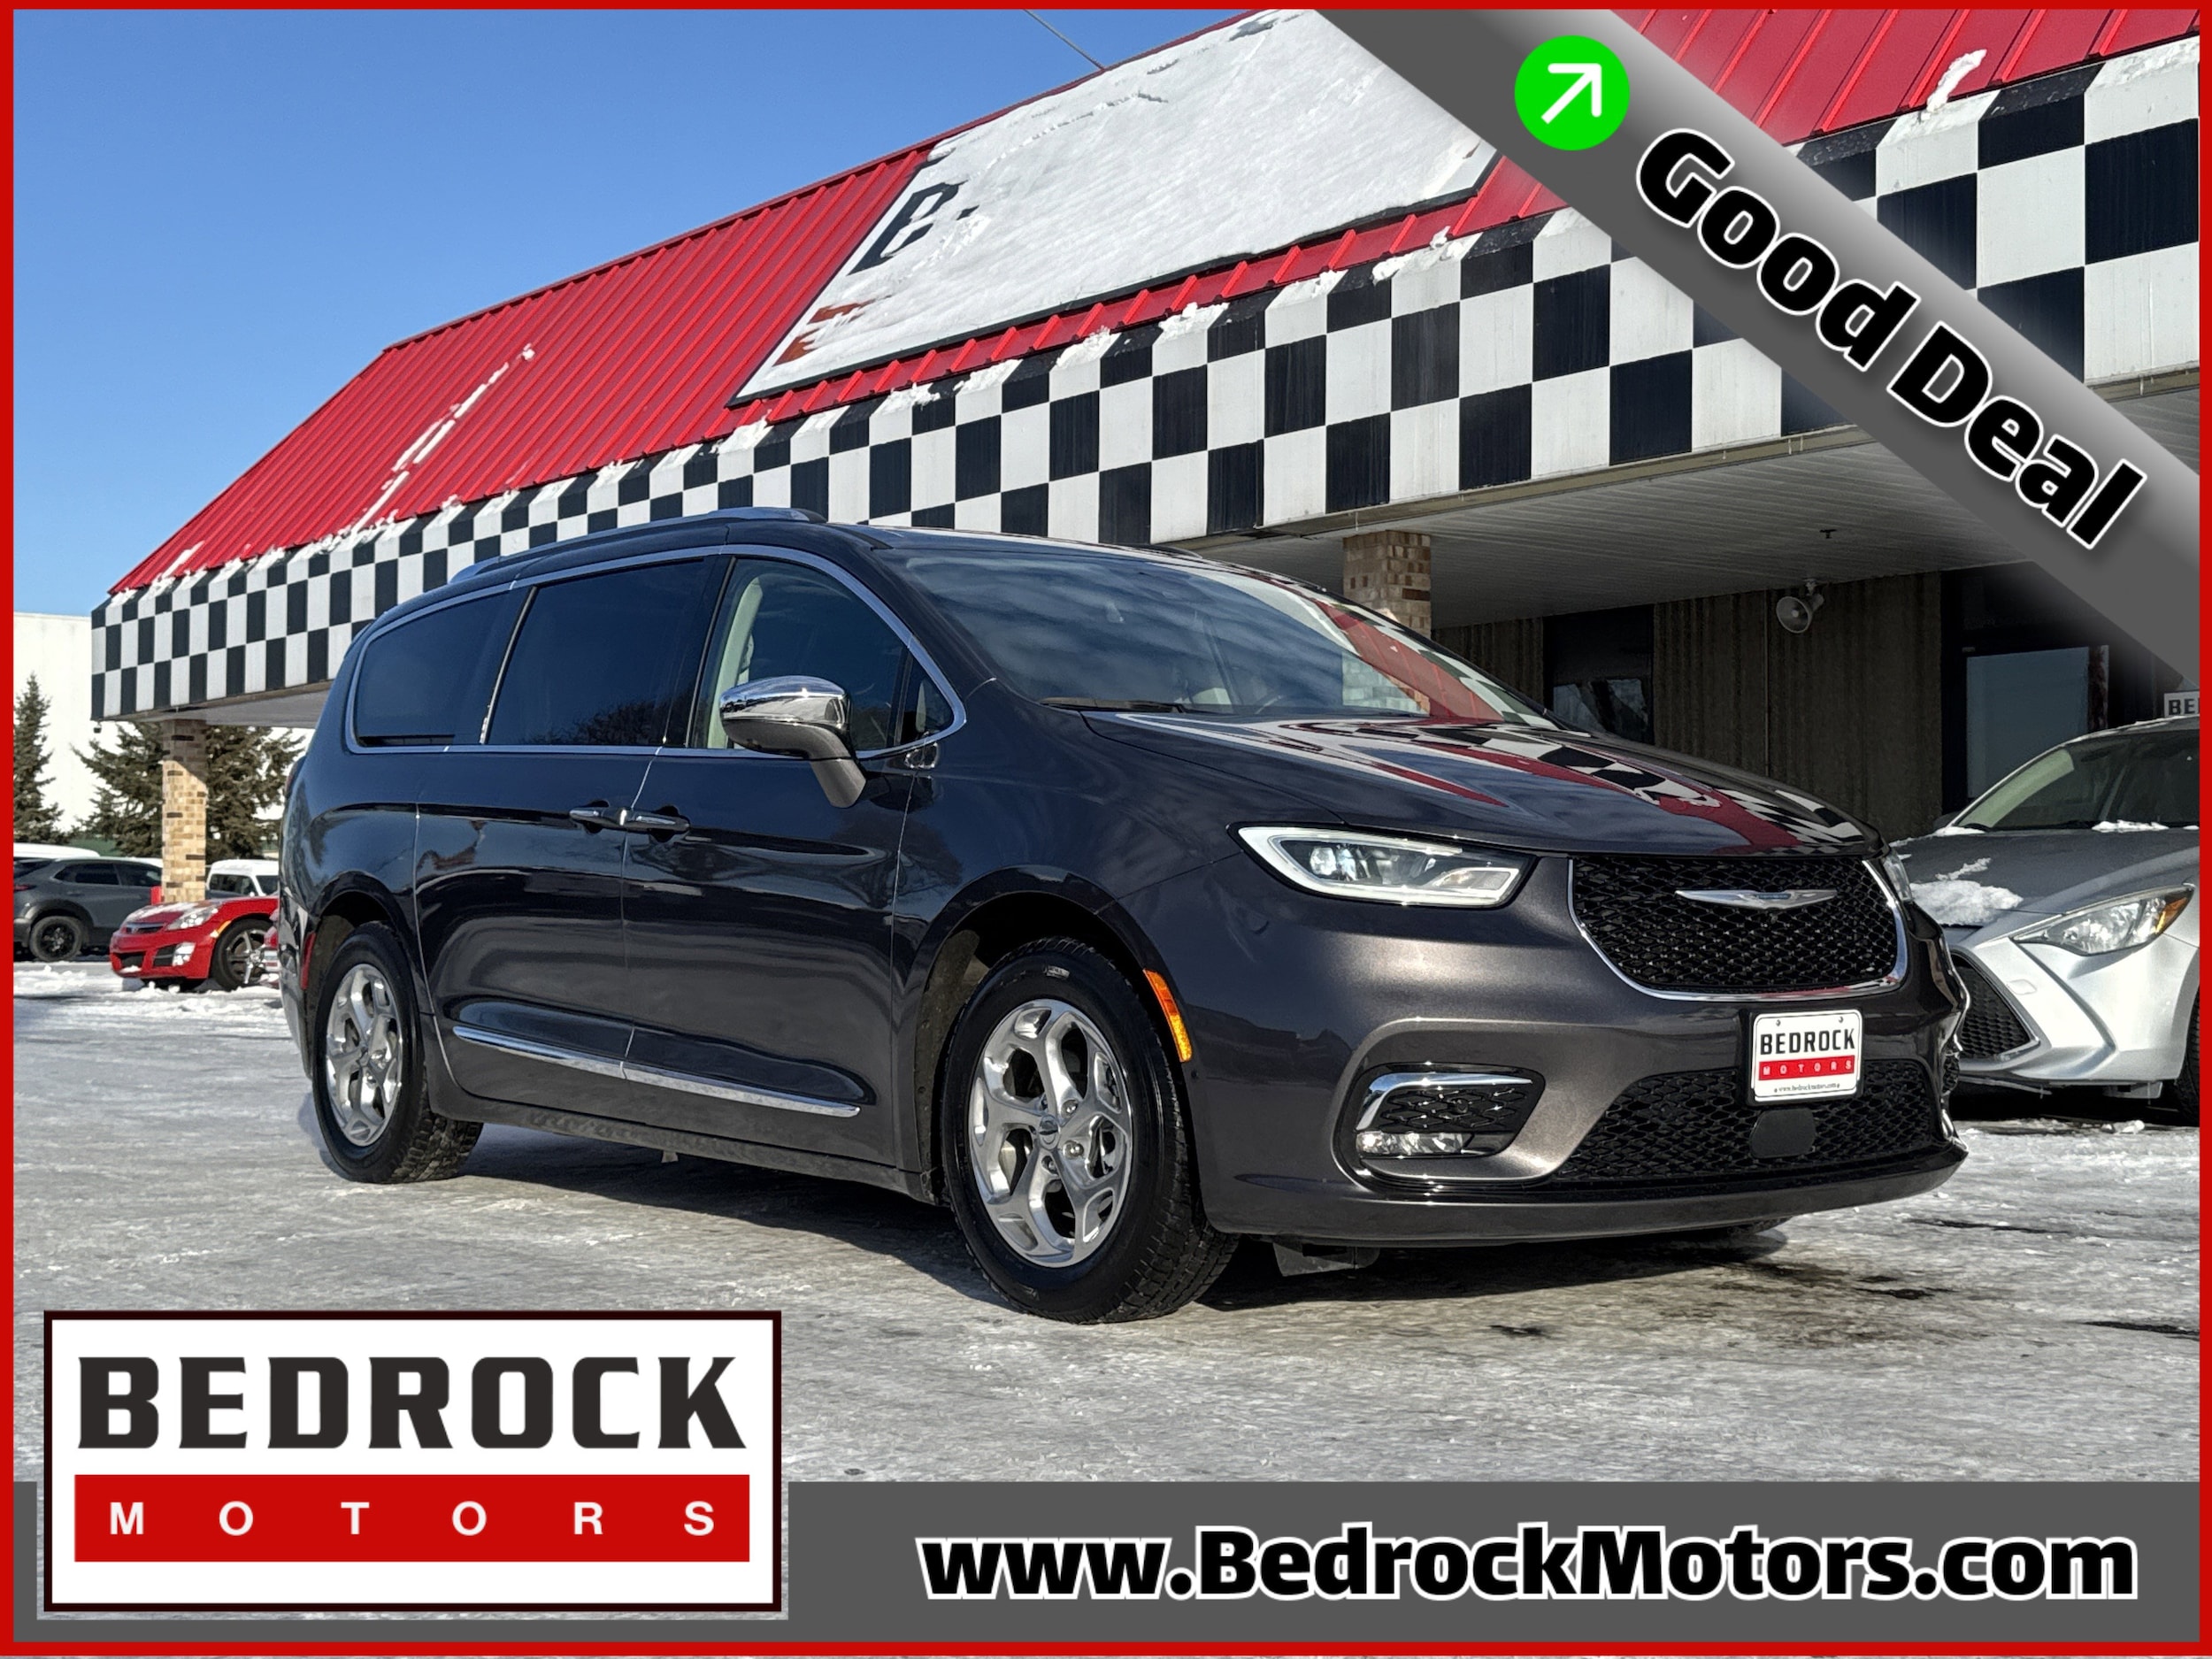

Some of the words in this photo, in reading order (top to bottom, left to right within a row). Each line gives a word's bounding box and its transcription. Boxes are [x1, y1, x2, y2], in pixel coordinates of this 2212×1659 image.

[2168, 698, 2200, 715] BE
[1760, 1028, 1855, 1056] BEDROCK
[1763, 1060, 1851, 1076] MOTORS
